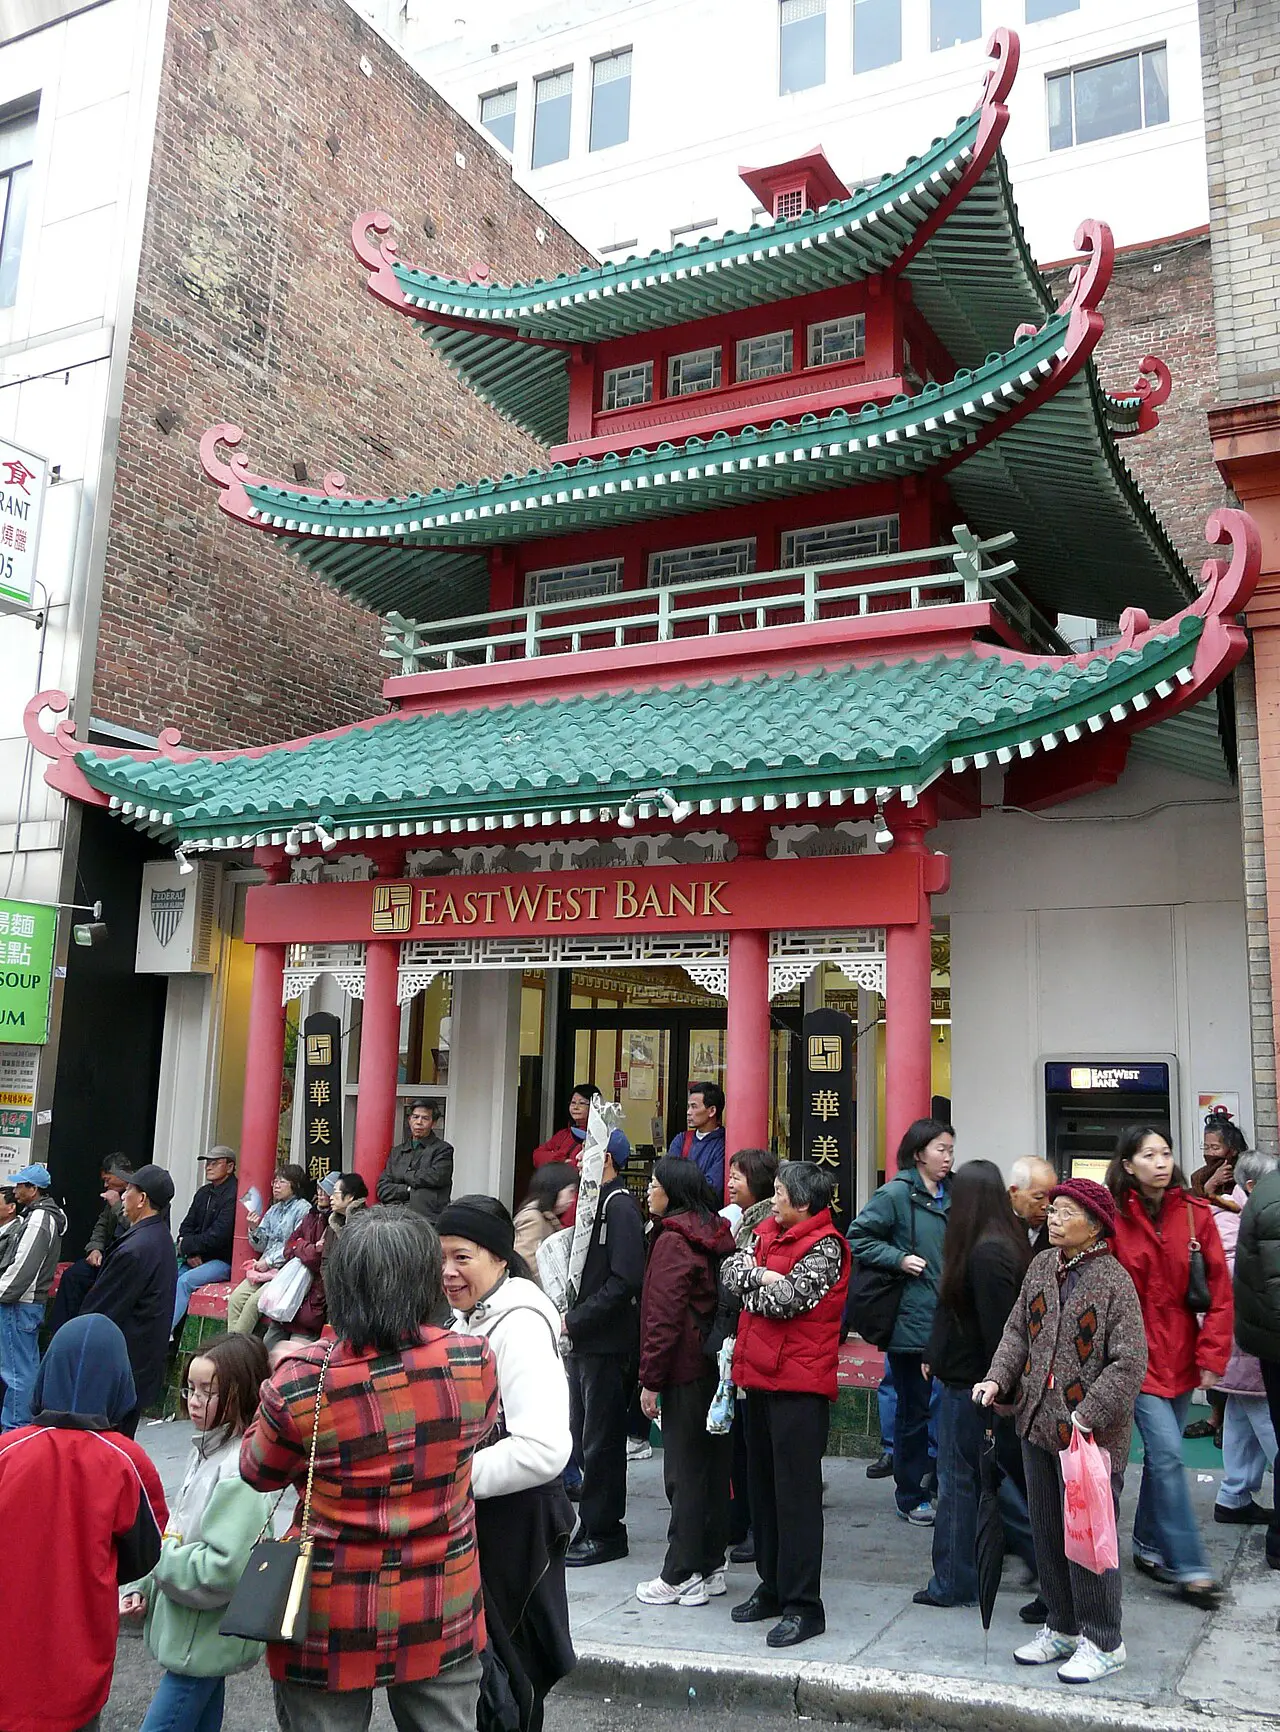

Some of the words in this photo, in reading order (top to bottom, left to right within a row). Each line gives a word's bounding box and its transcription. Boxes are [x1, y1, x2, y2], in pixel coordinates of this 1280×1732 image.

[152, 891, 185, 901] FEDERAL
[613, 879, 732, 919] BANK
[1091, 1078, 1120, 1088] BANK
